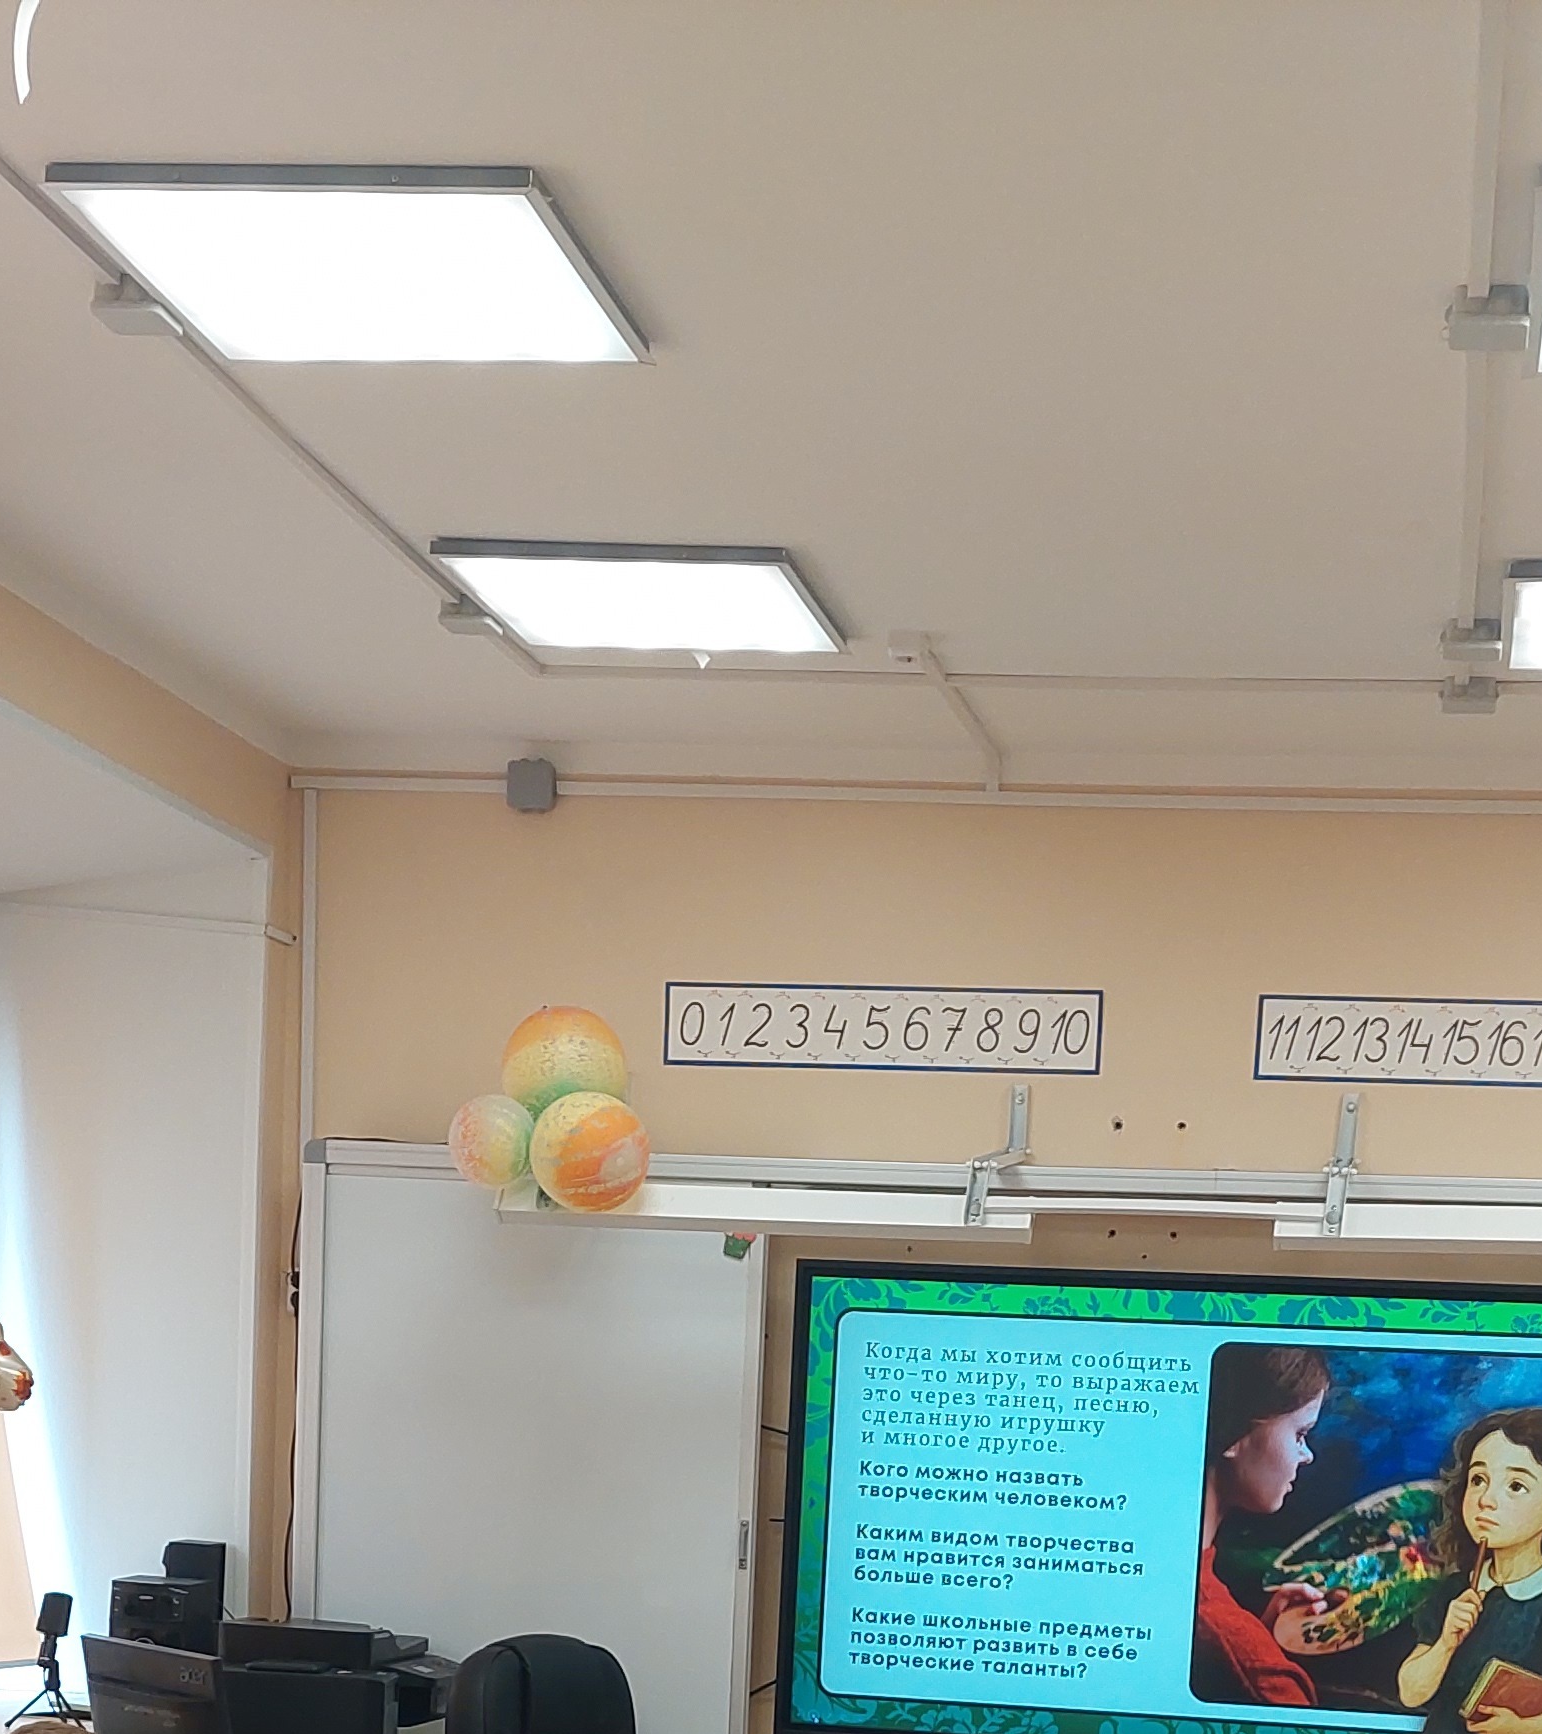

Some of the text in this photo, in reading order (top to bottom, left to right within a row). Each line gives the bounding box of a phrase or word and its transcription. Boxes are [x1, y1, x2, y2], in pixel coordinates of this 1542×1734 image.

[865, 1341, 1192, 1373] Когда мы хотим сообщить
[864, 1367, 1200, 1397] что-то миру, то выражаем
[862, 1388, 1159, 1419] это через танец, песню,
[861, 1408, 1106, 1438] сделанную игрушку
[861, 1431, 1066, 1455] и многое другое.
[859, 1460, 1084, 1487] Кого можно назвать
[857, 1484, 1128, 1511] творческим человеком?
[856, 1523, 1134, 1554] Каким видом творчества
[855, 1546, 1144, 1577] вам нравится заниматься
[854, 1566, 1014, 1590] больше всего?
[851, 1607, 1152, 1641] Какие школьные предметы
[850, 1630, 1138, 1661] позволяют развить в себе
[849, 1651, 1088, 1679] творческие таланты?
